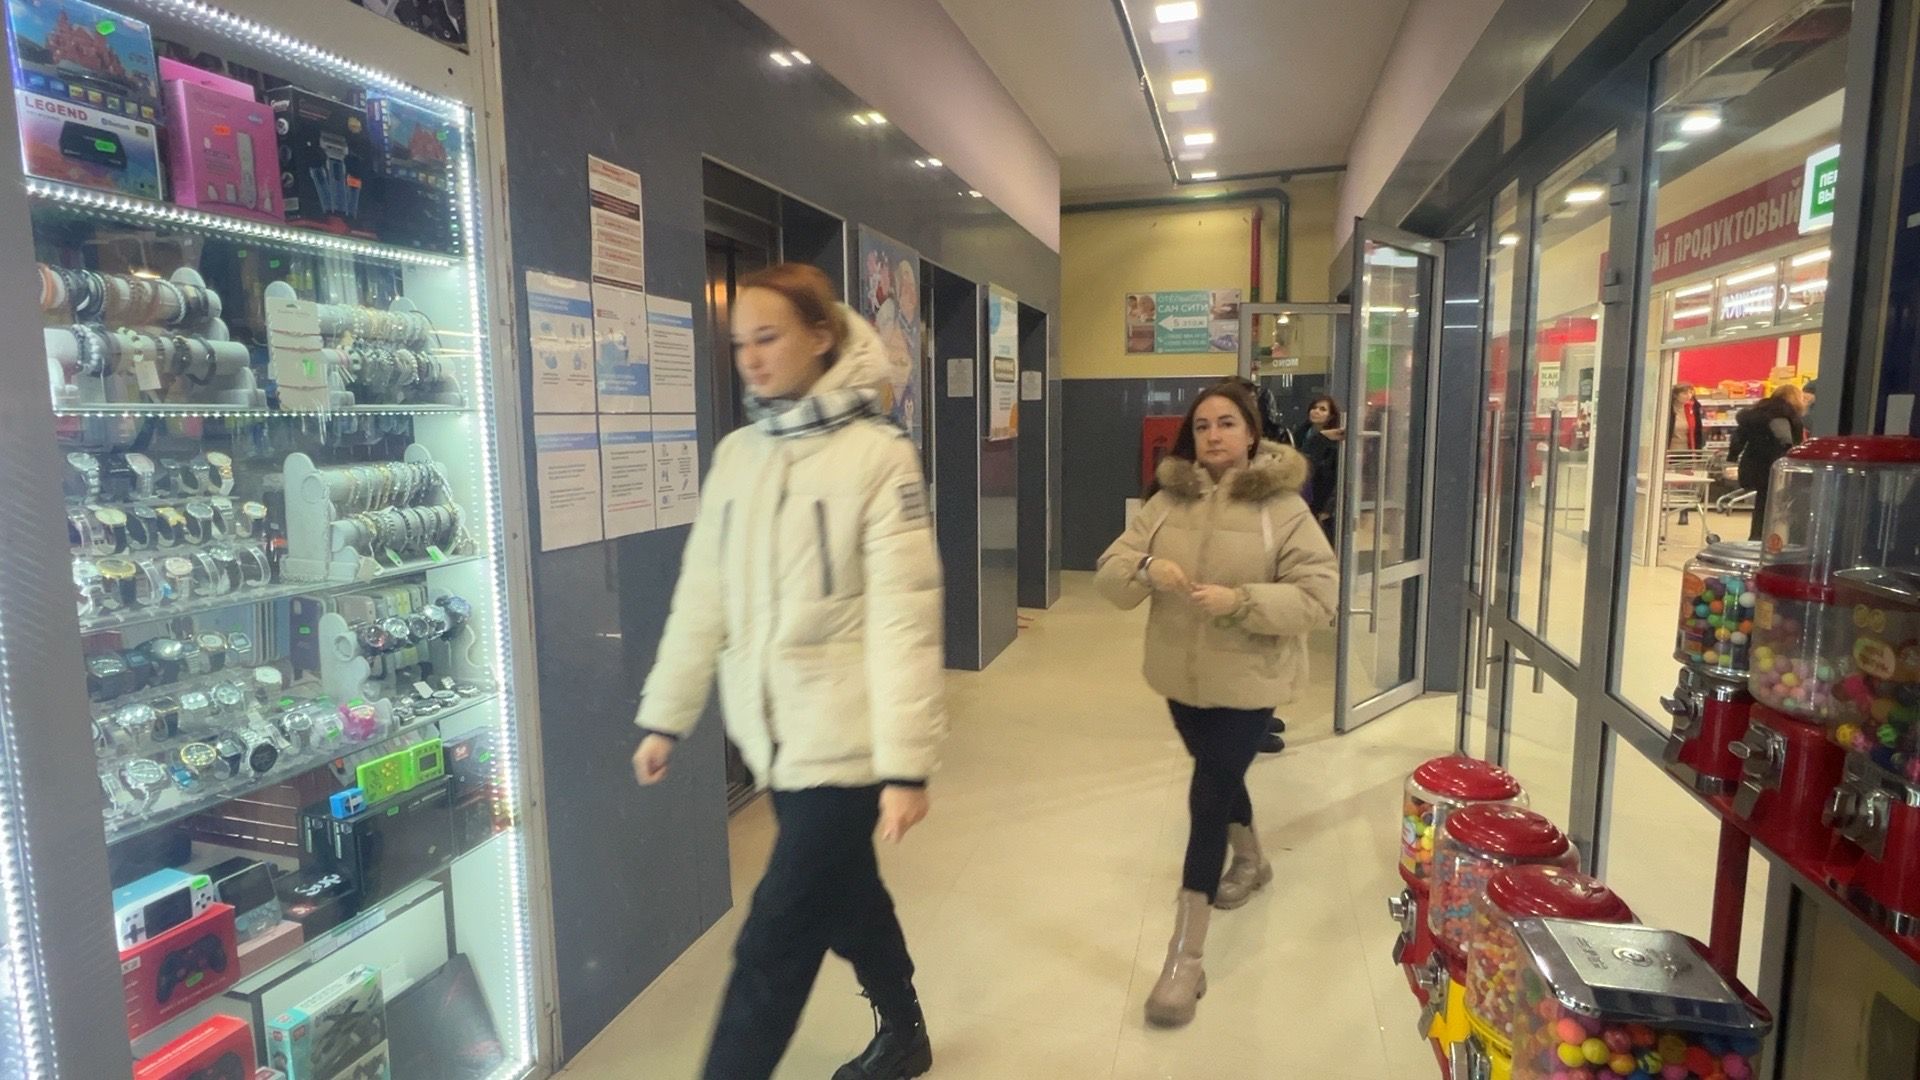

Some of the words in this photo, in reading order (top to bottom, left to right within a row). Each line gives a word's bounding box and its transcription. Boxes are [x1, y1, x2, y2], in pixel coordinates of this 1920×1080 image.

[25, 96, 88, 121] LEGEND
[1673, 176, 1801, 264] ПРОДУКТОВЫЙ
[1158, 304, 1179, 313] САН
[1181, 304, 1208, 312] СИТИ
